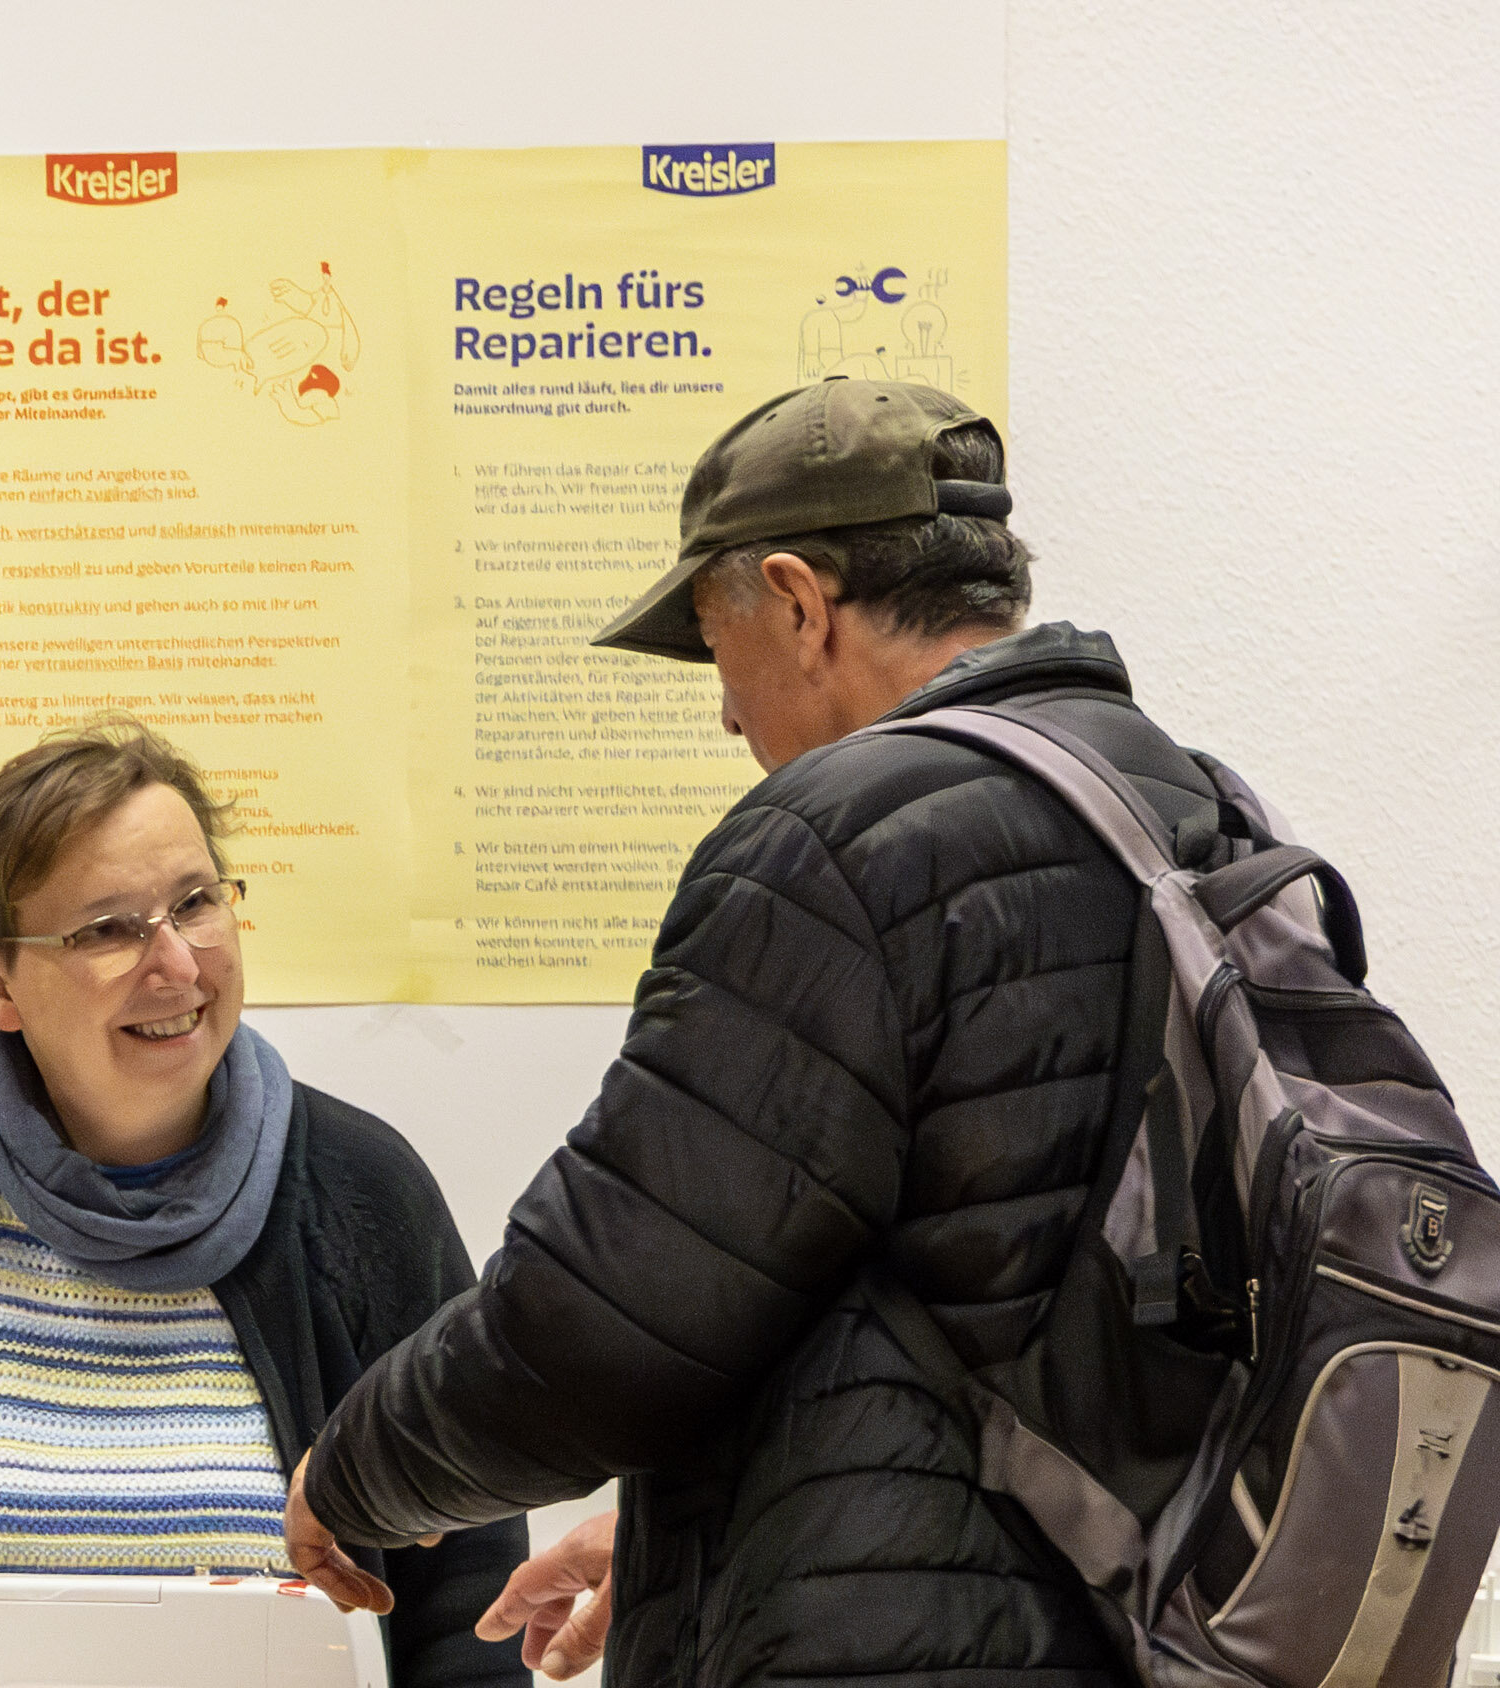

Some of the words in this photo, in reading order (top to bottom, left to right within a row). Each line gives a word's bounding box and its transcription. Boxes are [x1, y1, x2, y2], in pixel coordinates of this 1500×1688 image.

[53, 159, 172, 201] Kreisler
[649, 150, 771, 193] Kreisler
[37, 279, 110, 318] der
[455, 273, 603, 320] Regeln
[616, 271, 705, 310] fürs
[28, 328, 82, 366] da
[95, 327, 162, 365] ist.
[455, 321, 712, 368] Reparieren.
[19, 387, 49, 405] gibt
[51, 390, 69, 402] es
[453, 383, 498, 396] Damit
[501, 382, 536, 396] alles
[539, 381, 575, 396] rund
[649, 380, 669, 394] dir
[673, 382, 724, 394] unsere
[556, 402, 581, 418] gut
